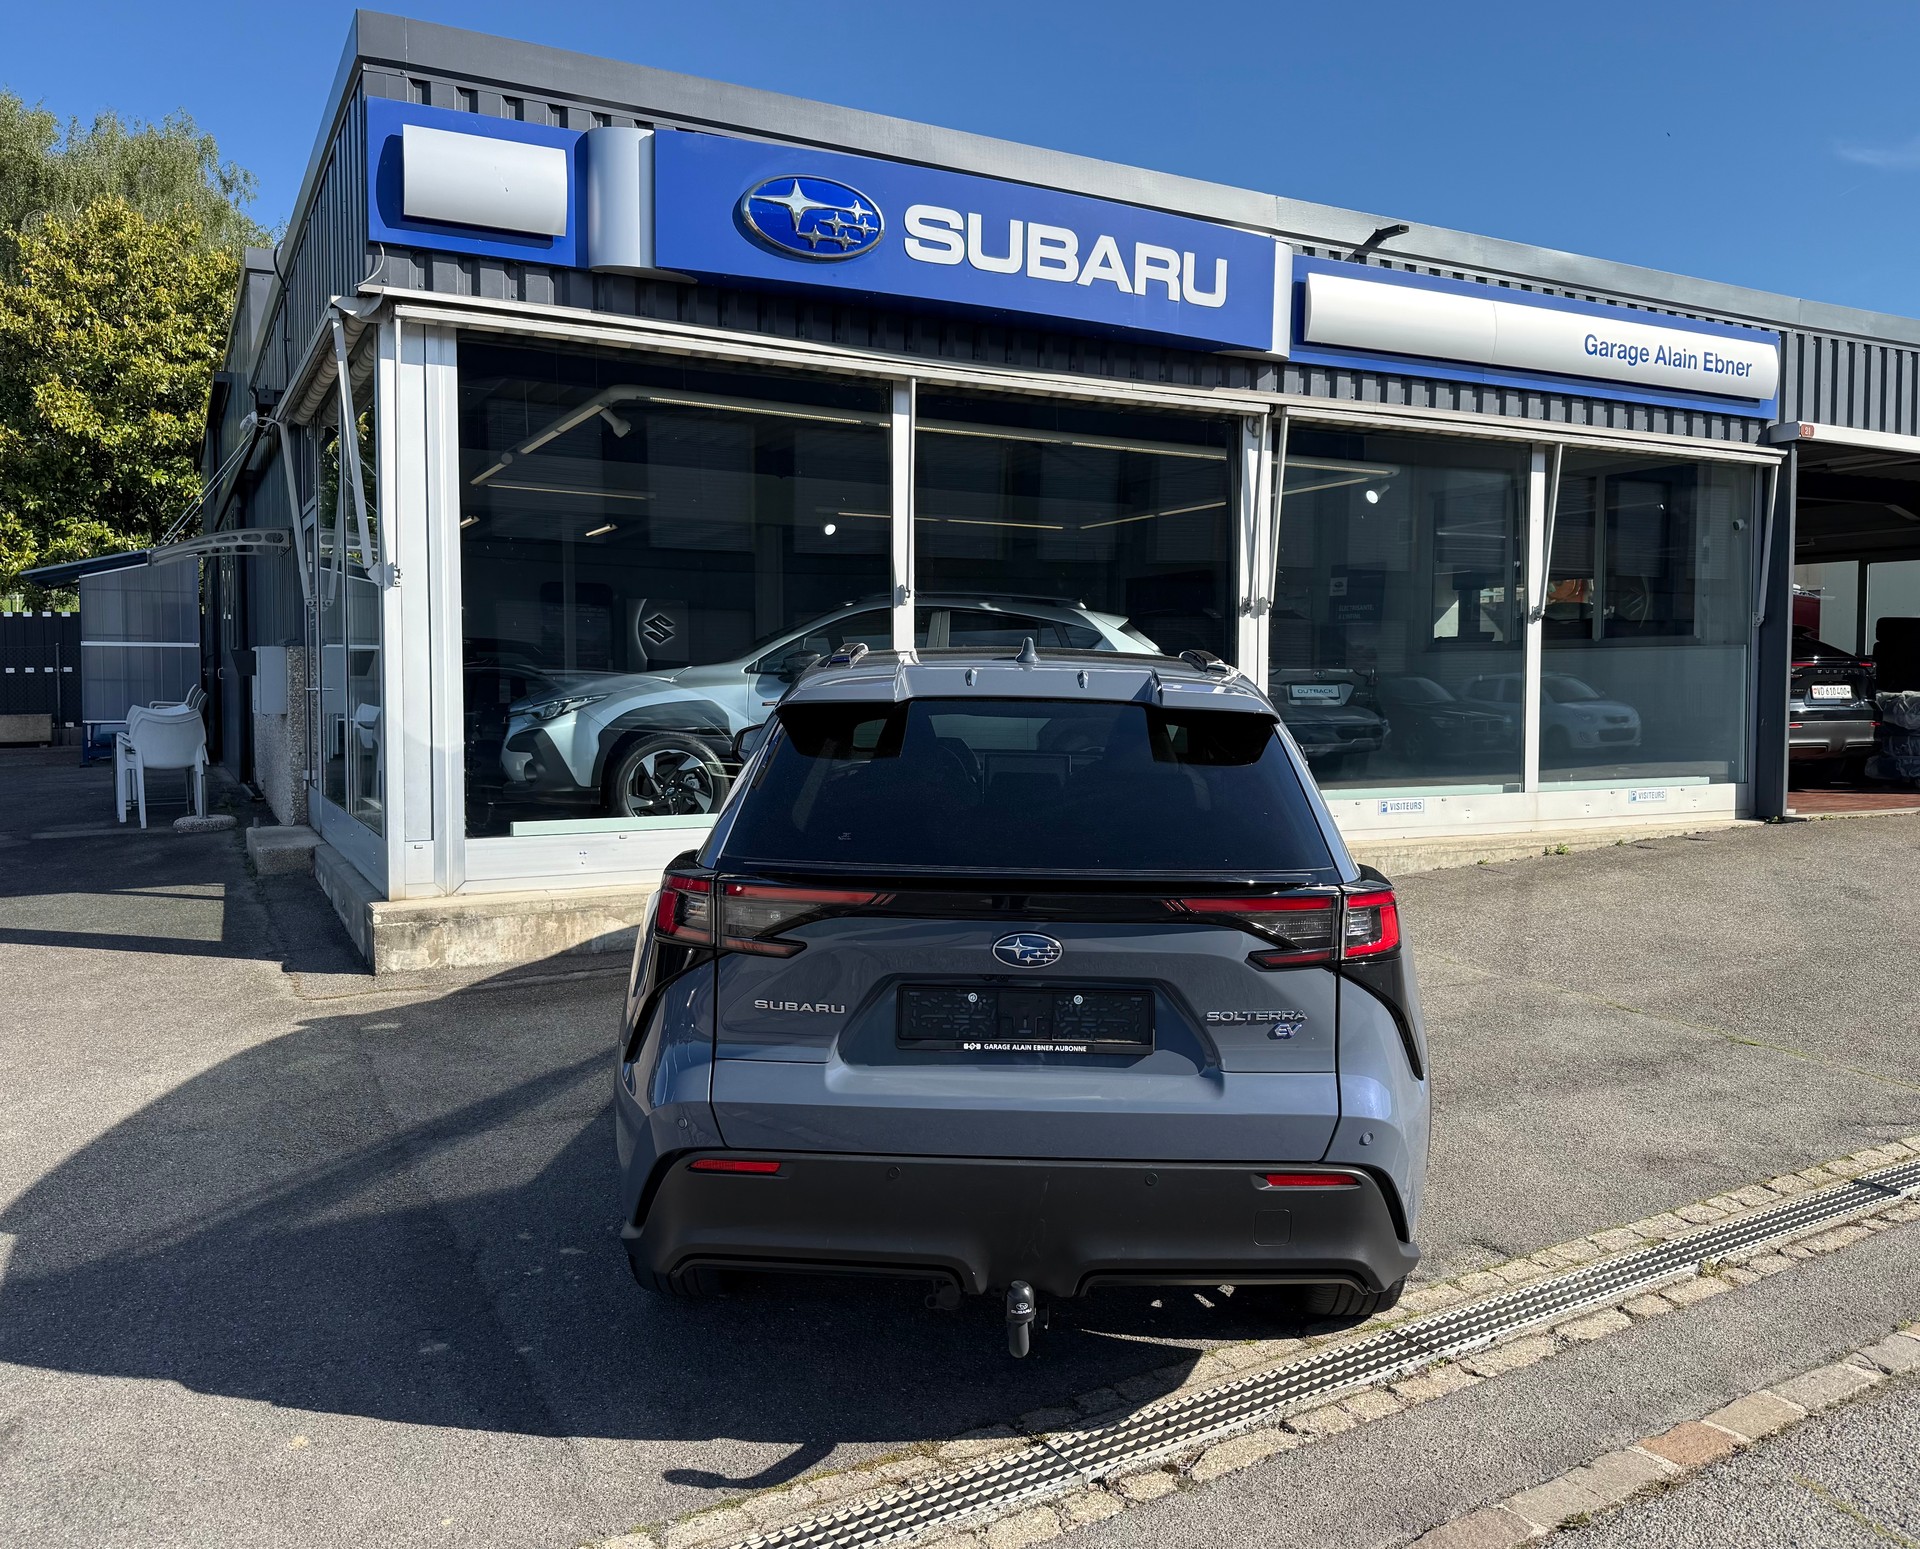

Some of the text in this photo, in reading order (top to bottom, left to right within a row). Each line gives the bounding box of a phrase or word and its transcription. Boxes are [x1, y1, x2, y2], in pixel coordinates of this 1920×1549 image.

[903, 203, 1229, 309] SUBARU
[1584, 333, 1753, 378] Garage Alain Ebner
[1638, 790, 1665, 800] VISITEURS
[1390, 801, 1422, 811] VISITEURS
[754, 999, 845, 1014] SUBARU
[1206, 1009, 1308, 1022] SOLTERRA
[1274, 1022, 1303, 1037] EV
[1012, 1043, 1032, 1051] ALAIN
